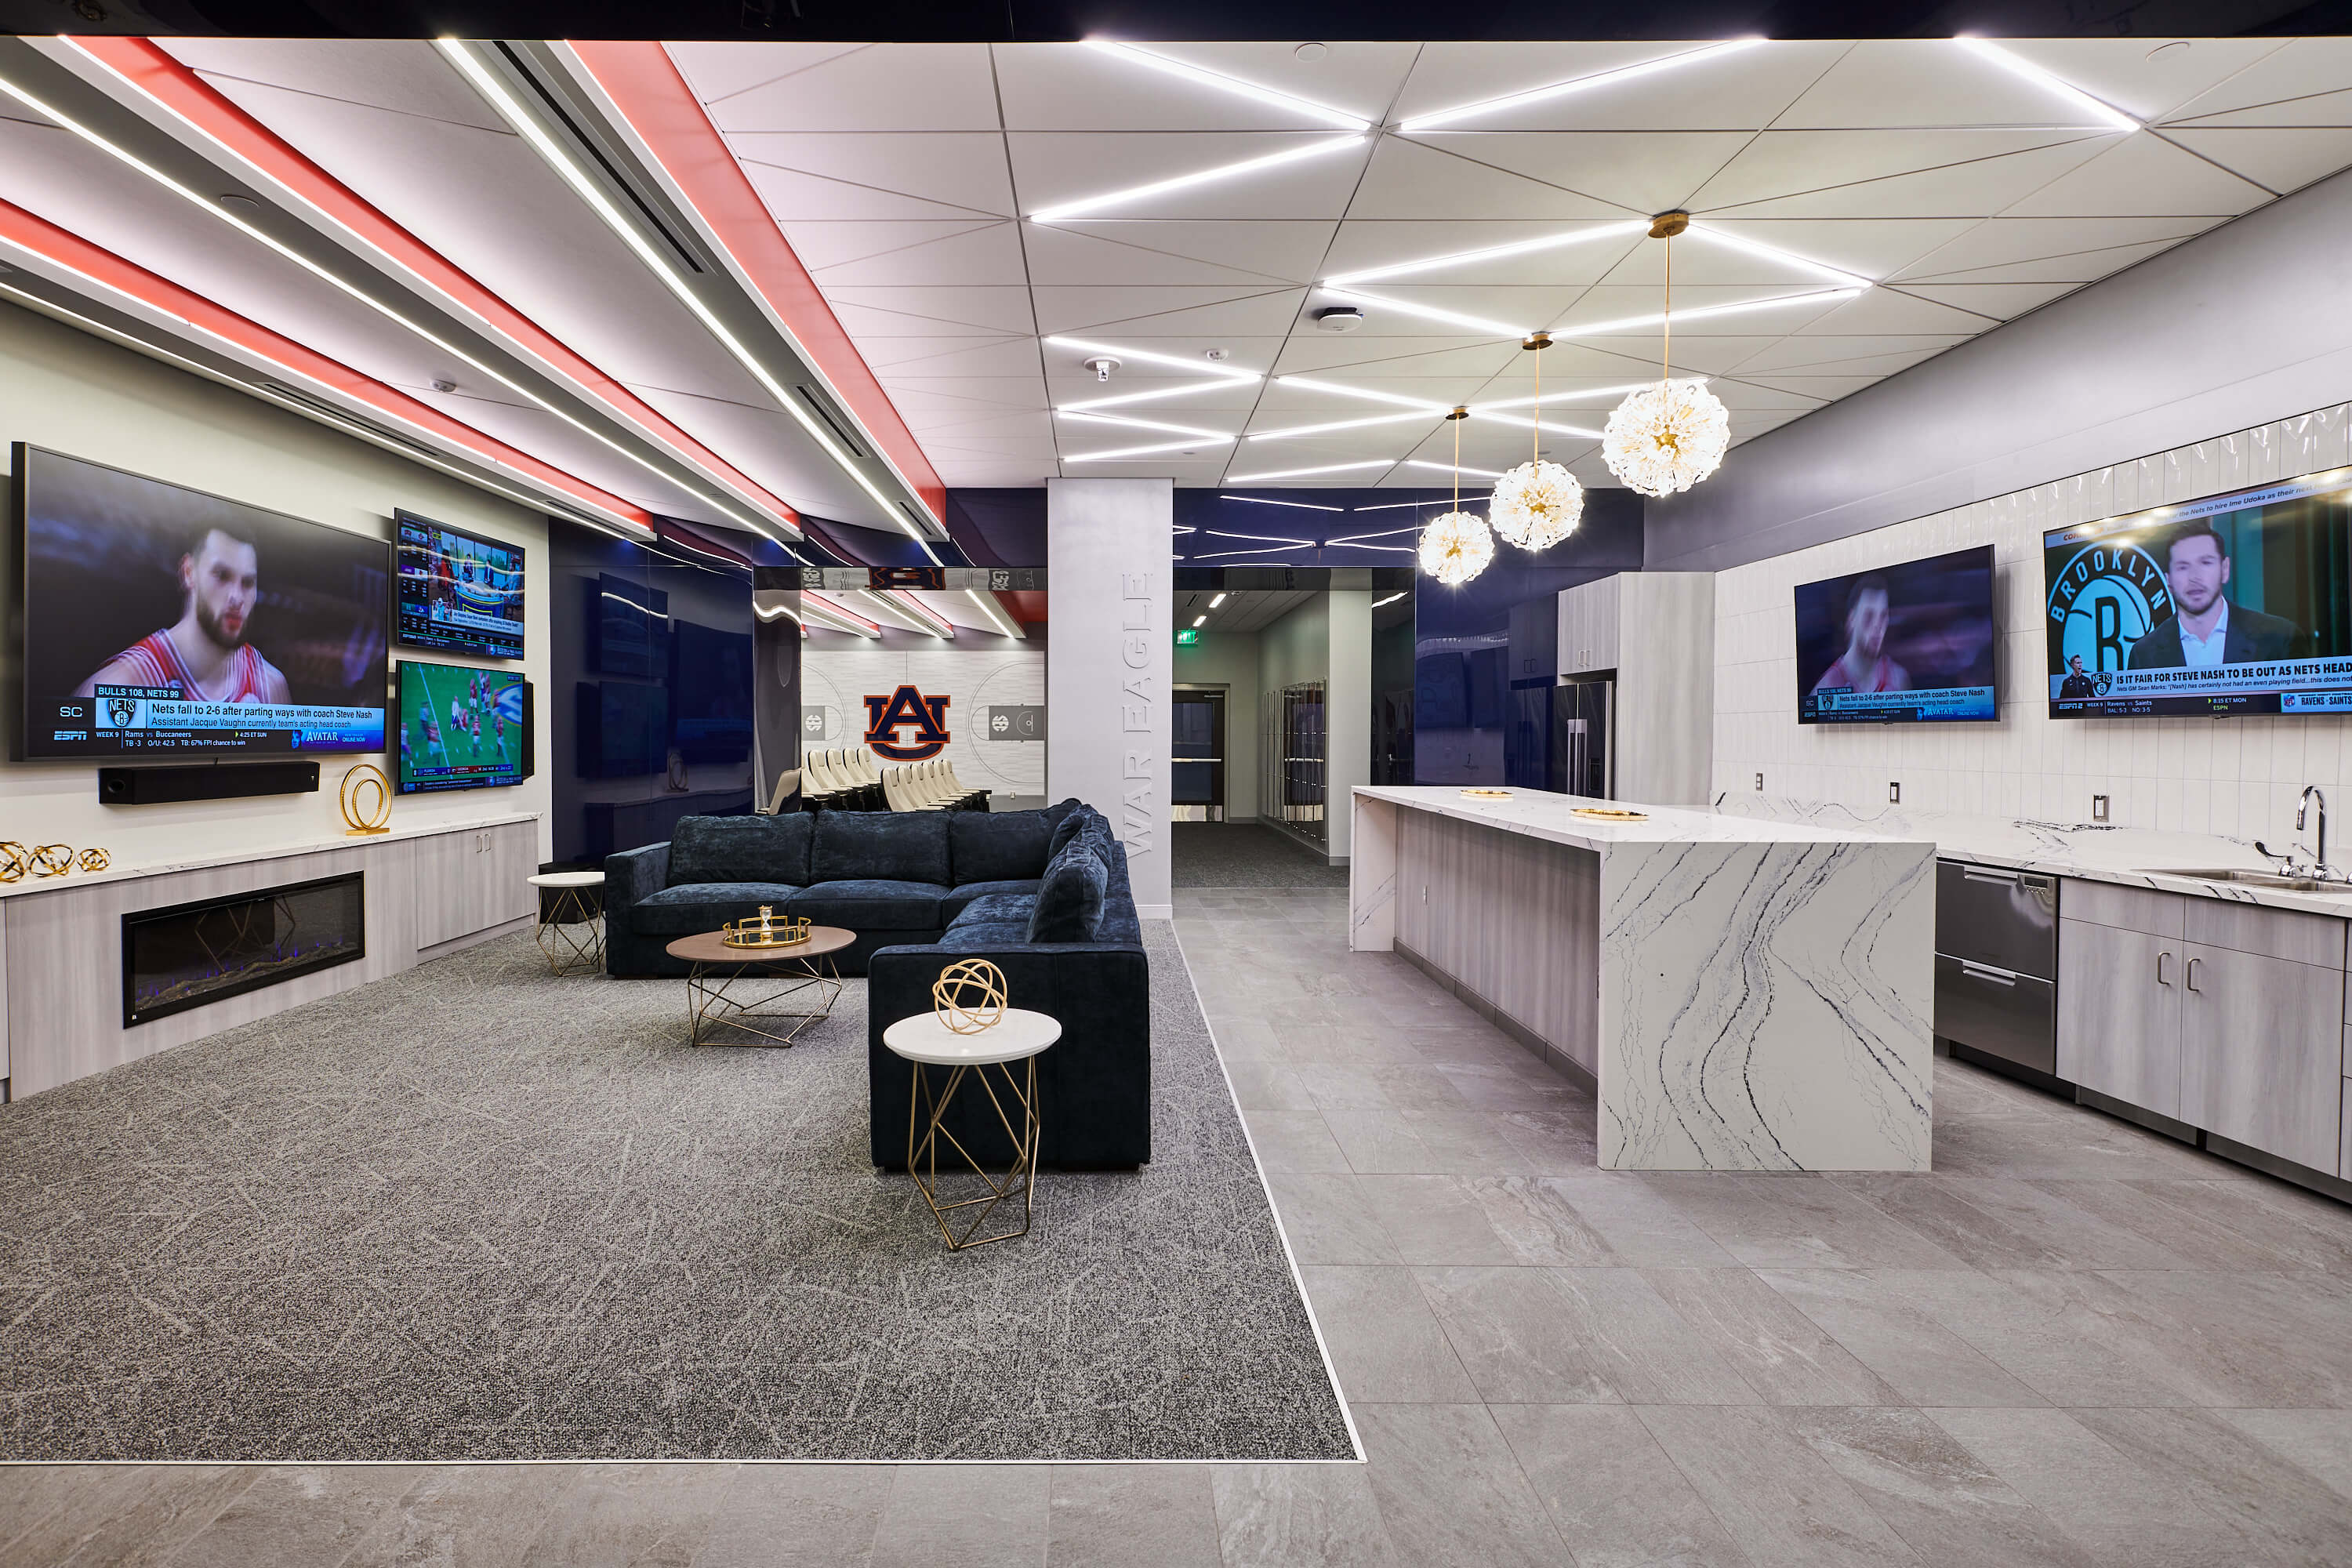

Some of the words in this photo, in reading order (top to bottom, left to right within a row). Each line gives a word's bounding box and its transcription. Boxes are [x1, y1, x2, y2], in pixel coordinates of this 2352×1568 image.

[2244, 495, 2266, 504] Udoka
[2277, 488, 2294, 497] their
[2051, 548, 2166, 622] BROOKLYN
[1123, 573, 1153, 733] EAGLE
[2092, 673, 2111, 684] NETS
[2117, 676, 2124, 684] IS
[2125, 675, 2133, 684] IT
[2135, 673, 2152, 683] FAIR
[2154, 673, 2171, 682] FOR
[2172, 671, 2198, 681] STEVE
[2201, 670, 2225, 680] NASH
[2227, 669, 2240, 678] TO
[2242, 668, 2254, 677] BE
[2256, 666, 2276, 677] OUT
[2278, 666, 2292, 676] AS
[2294, 664, 2321, 675] NETS
[2323, 662, 2352, 673] HEAD
[2268, 677, 2290, 686] playing
[98, 687, 126, 696] BULLS
[129, 688, 145, 699] 108,
[147, 689, 168, 698] NETS
[109, 699, 135, 712] NETS
[2301, 696, 2325, 706] RAVENS
[2328, 695, 2352, 705] SAINTS
[60, 706, 82, 717] SC
[152, 703, 175, 714] Nets
[178, 704, 192, 714] fall
[195, 706, 204, 714] to
[206, 705, 220, 715] 2-6
[223, 706, 242, 716] after
[245, 707, 273, 718] parting
[275, 709, 295, 718] ways
[296, 708, 311, 717] with
[313, 709, 334, 717] coach
[336, 710, 354, 718] Steve
[356, 710, 372, 719] Nash
[151, 717, 188, 726] Assistant
[191, 717, 217, 728] Jacque
[220, 718, 246, 728] Vaughn
[248, 719, 276, 728] currently
[54, 731, 87, 740] ESPN
[307, 731, 339, 742] AVATAR
[1123, 749, 1153, 858] WAR
